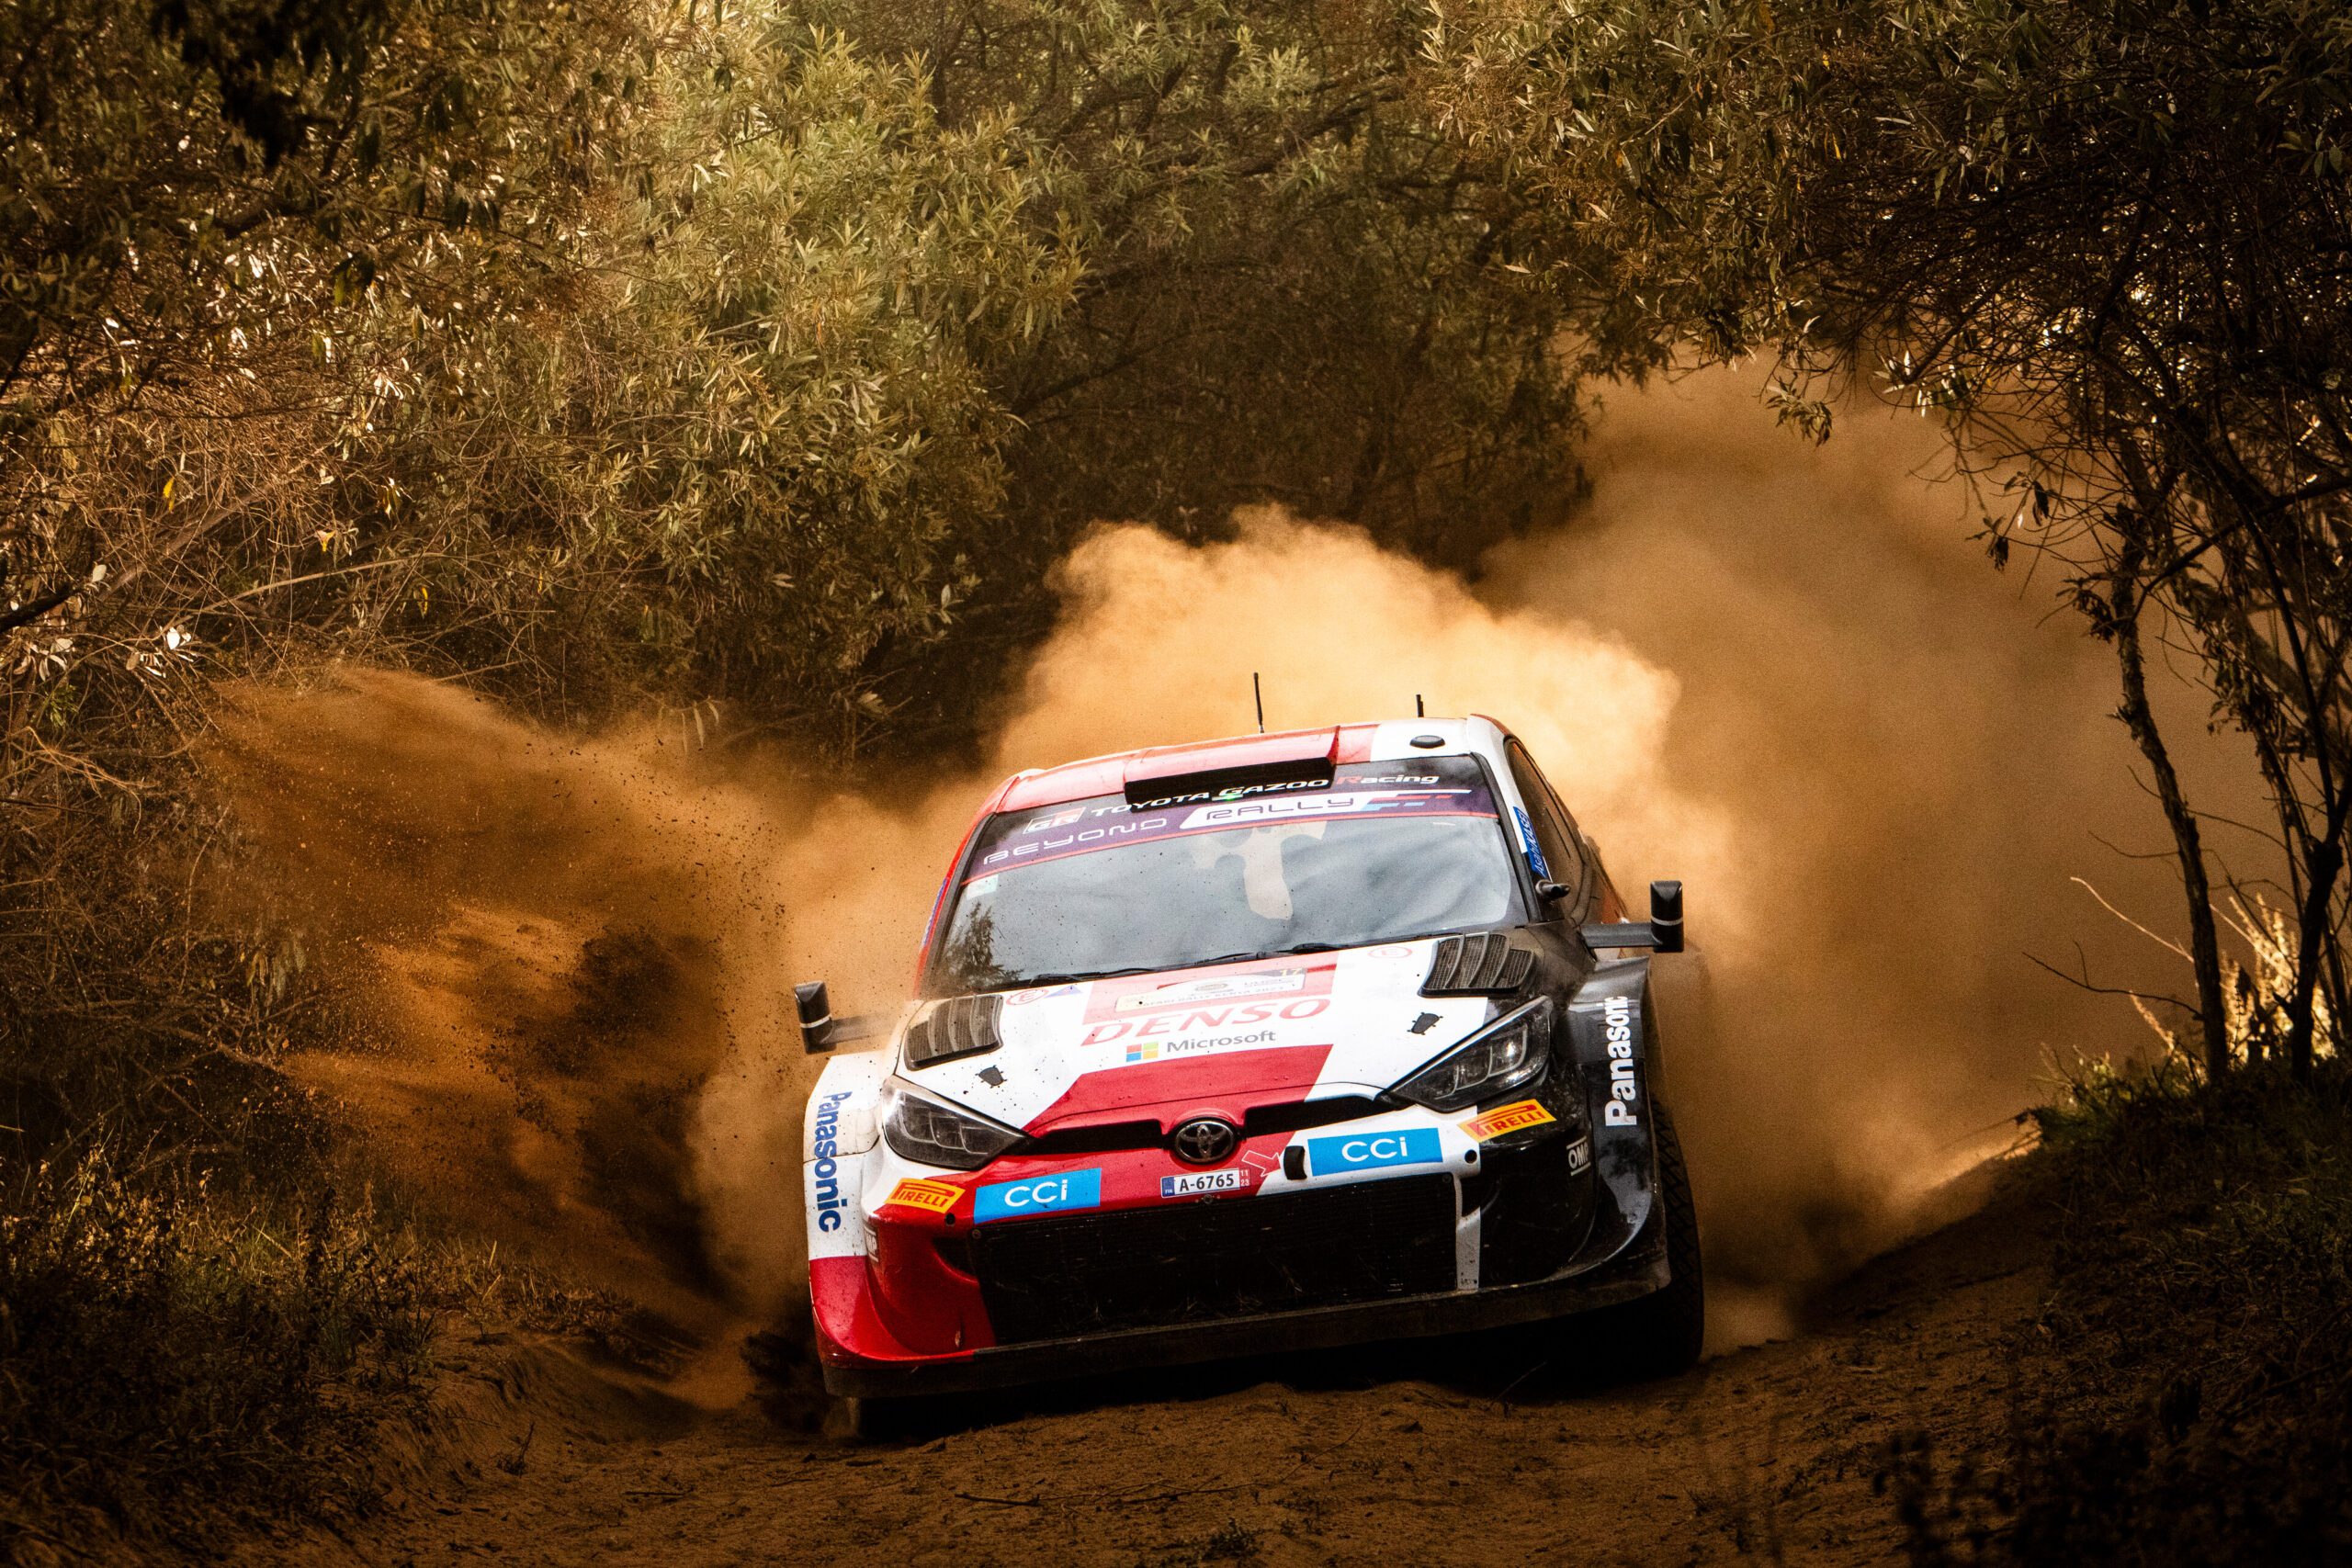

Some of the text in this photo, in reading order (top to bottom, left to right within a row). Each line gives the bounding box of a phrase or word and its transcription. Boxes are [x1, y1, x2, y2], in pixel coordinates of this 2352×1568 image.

[1091, 792, 1210, 817] TOYOTA
[1218, 778, 1329, 797] GAZOO
[1336, 774, 1440, 784] Racing
[983, 797, 1354, 865] BEYOND RALLY
[1080, 998, 1332, 1046] DENSO
[1166, 1030, 1277, 1054] Microsoft
[1604, 996, 1637, 1126] Panasonic
[1467, 1104, 1545, 1137] PIRELLI
[814, 1090, 853, 1233] Panasonic
[1180, 1174, 1235, 1192] A-6765
[891, 1181, 956, 1209] PIRELLI
